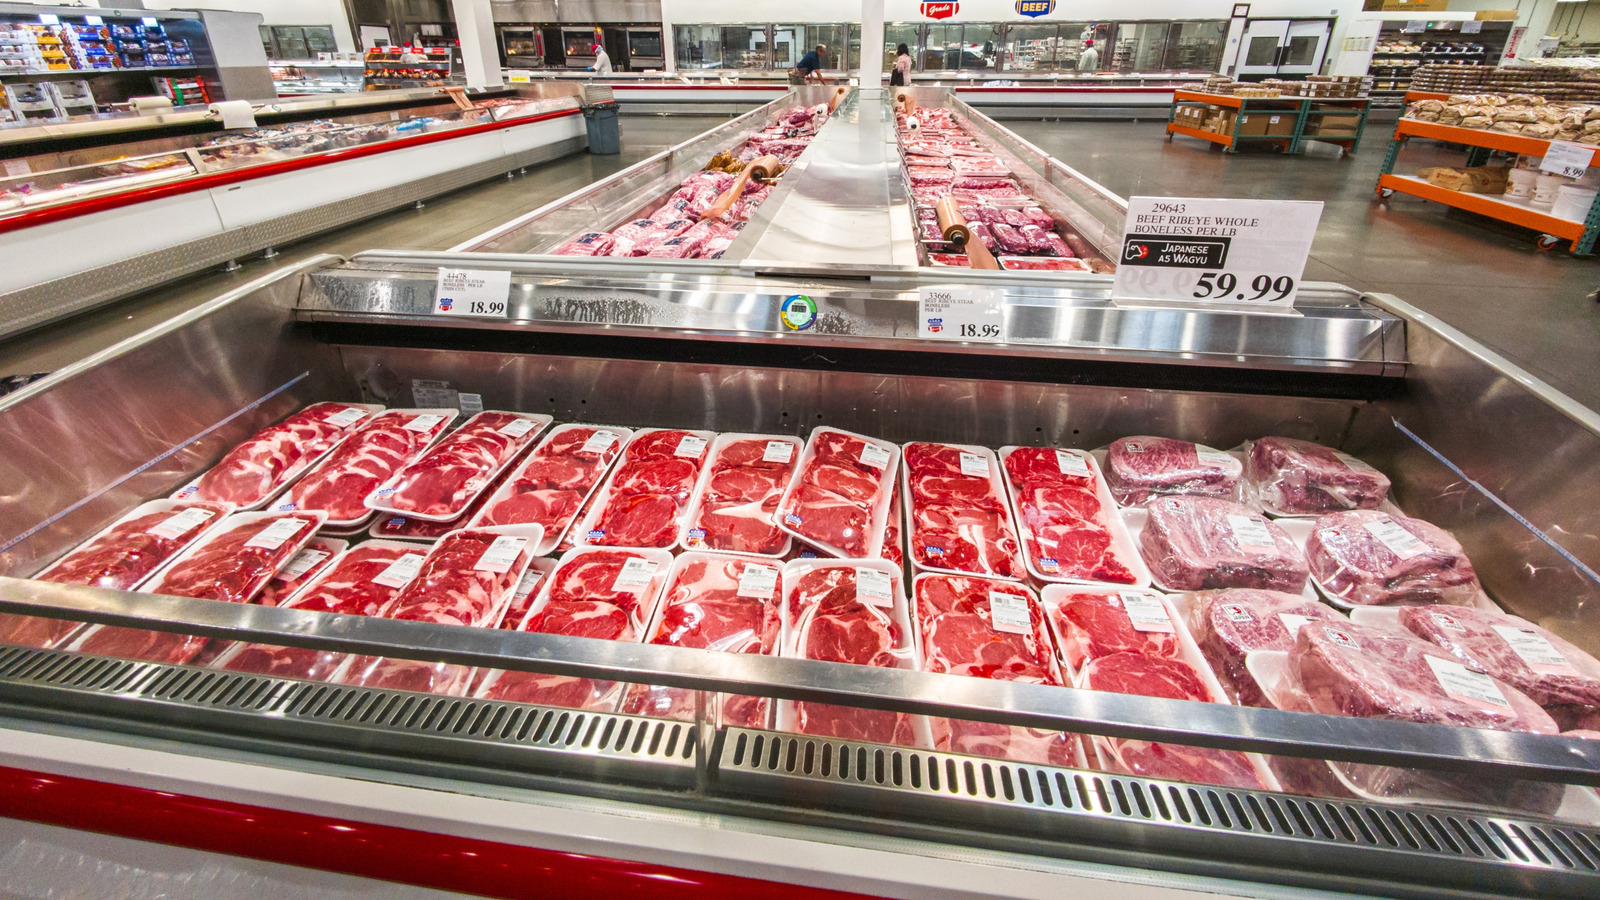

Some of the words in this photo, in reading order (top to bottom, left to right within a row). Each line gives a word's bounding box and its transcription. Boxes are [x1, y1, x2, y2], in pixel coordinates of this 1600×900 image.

[929, 4, 950, 16] Grade
[1022, 2, 1048, 12] BEEF
[1563, 166, 1584, 177] 8.99
[1151, 203, 1186, 213] 29643
[1136, 214, 1166, 223] BEEF
[1168, 215, 1210, 225] RIBEYE
[1214, 217, 1259, 227] WHOLE
[1134, 225, 1193, 235] BONELESS
[1196, 227, 1219, 236] PER
[1221, 228, 1237, 237] LB
[1192, 272, 1294, 302] 59.99
[928, 292, 951, 300] 33666
[469, 301, 504, 314] 18.99
[960, 324, 1000, 338] 18.99
